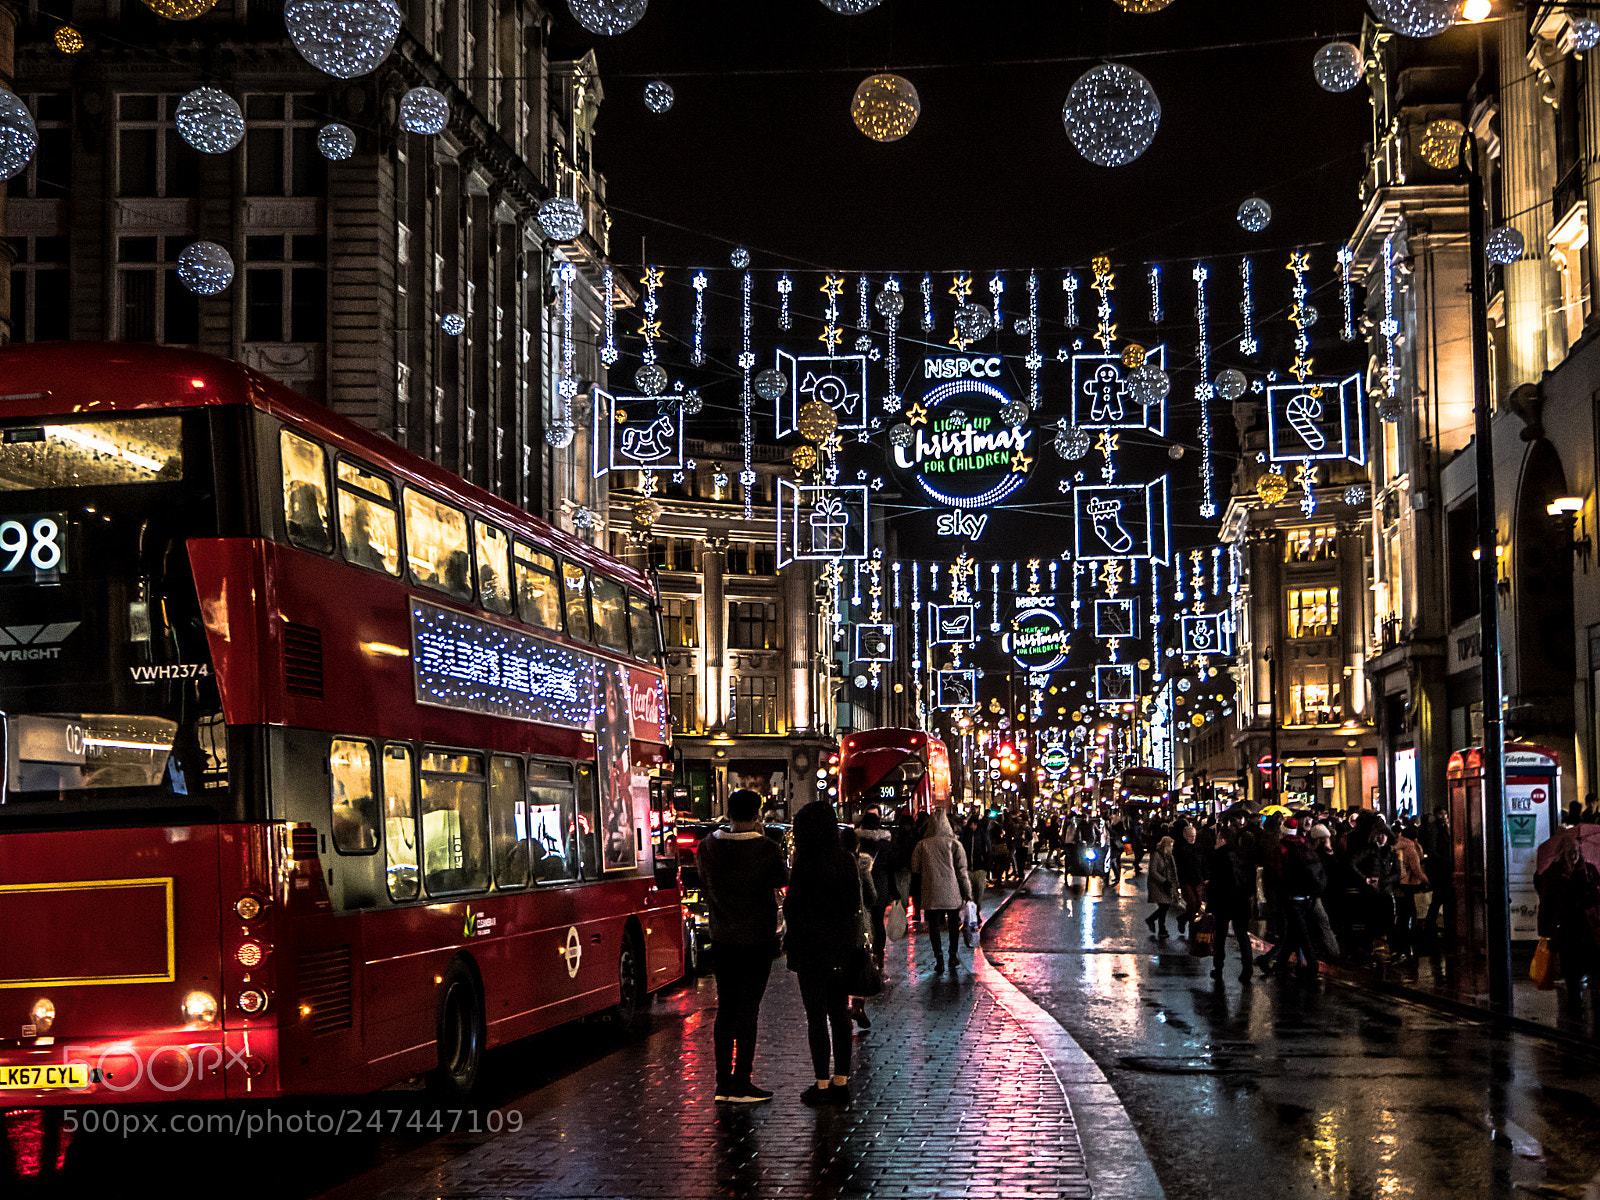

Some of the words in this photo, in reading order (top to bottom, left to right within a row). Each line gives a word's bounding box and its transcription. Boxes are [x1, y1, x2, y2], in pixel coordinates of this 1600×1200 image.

[924, 358, 1001, 378] NSPCC
[933, 417, 968, 432] LIGT
[974, 417, 991, 431] UP
[924, 461, 945, 473] FOR
[948, 450, 1010, 473] CHILDREN
[936, 508, 988, 541] sky
[0, 518, 61, 572] 98
[130, 663, 209, 680] VWH2374
[880, 786, 895, 798] 390
[47, 1067, 79, 1083] CYL
